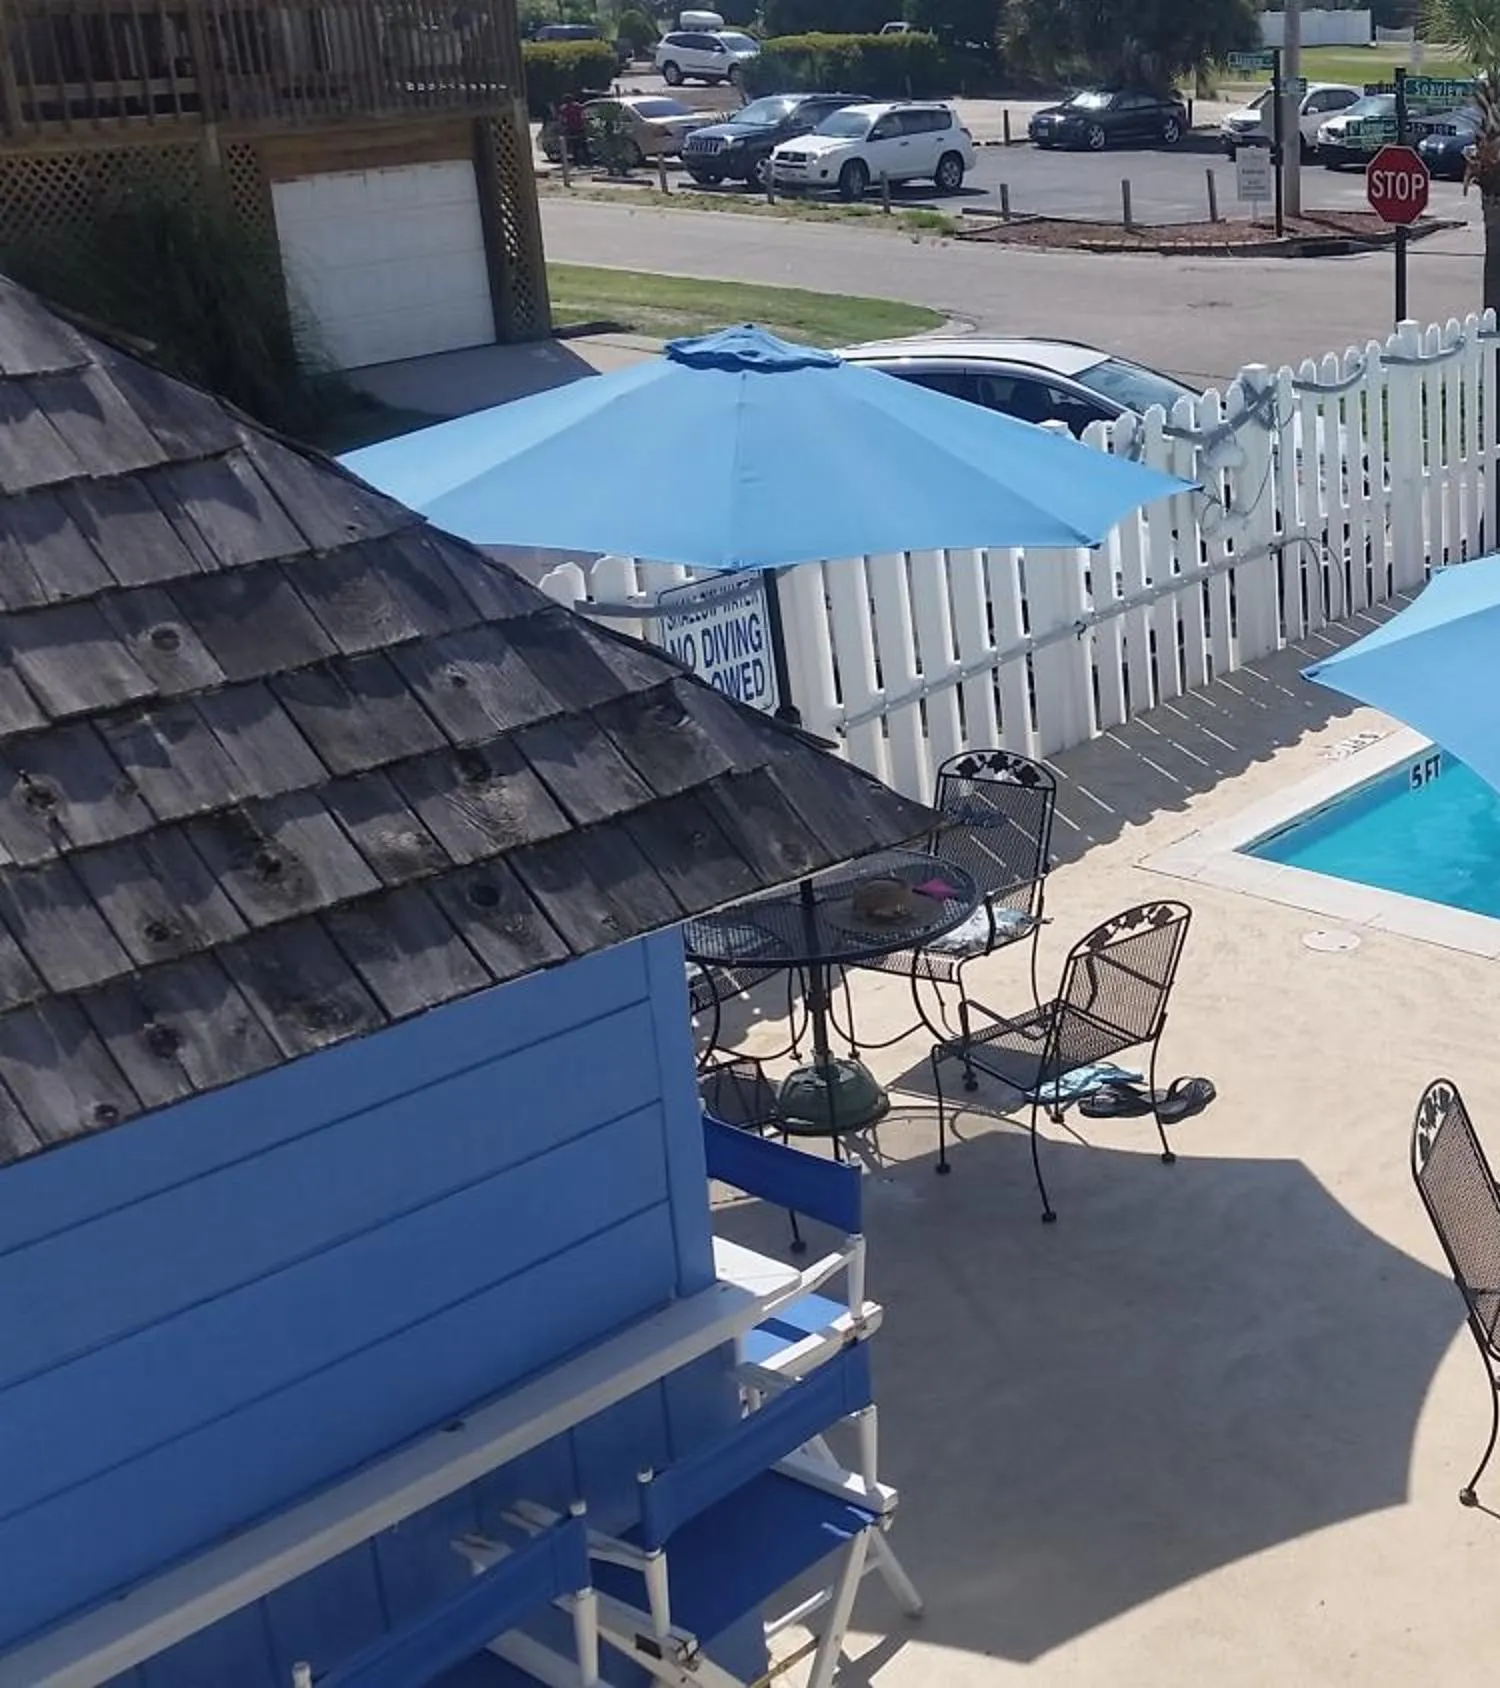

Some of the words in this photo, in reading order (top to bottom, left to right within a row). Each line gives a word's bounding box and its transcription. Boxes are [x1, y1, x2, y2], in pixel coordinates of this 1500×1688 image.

[1371, 169, 1425, 201] STOP
[669, 633, 697, 671] NO
[702, 613, 763, 669] DIVING
[711, 658, 765, 702] OWED
[1411, 764, 1422, 789] 5
[1426, 755, 1440, 783] FT
